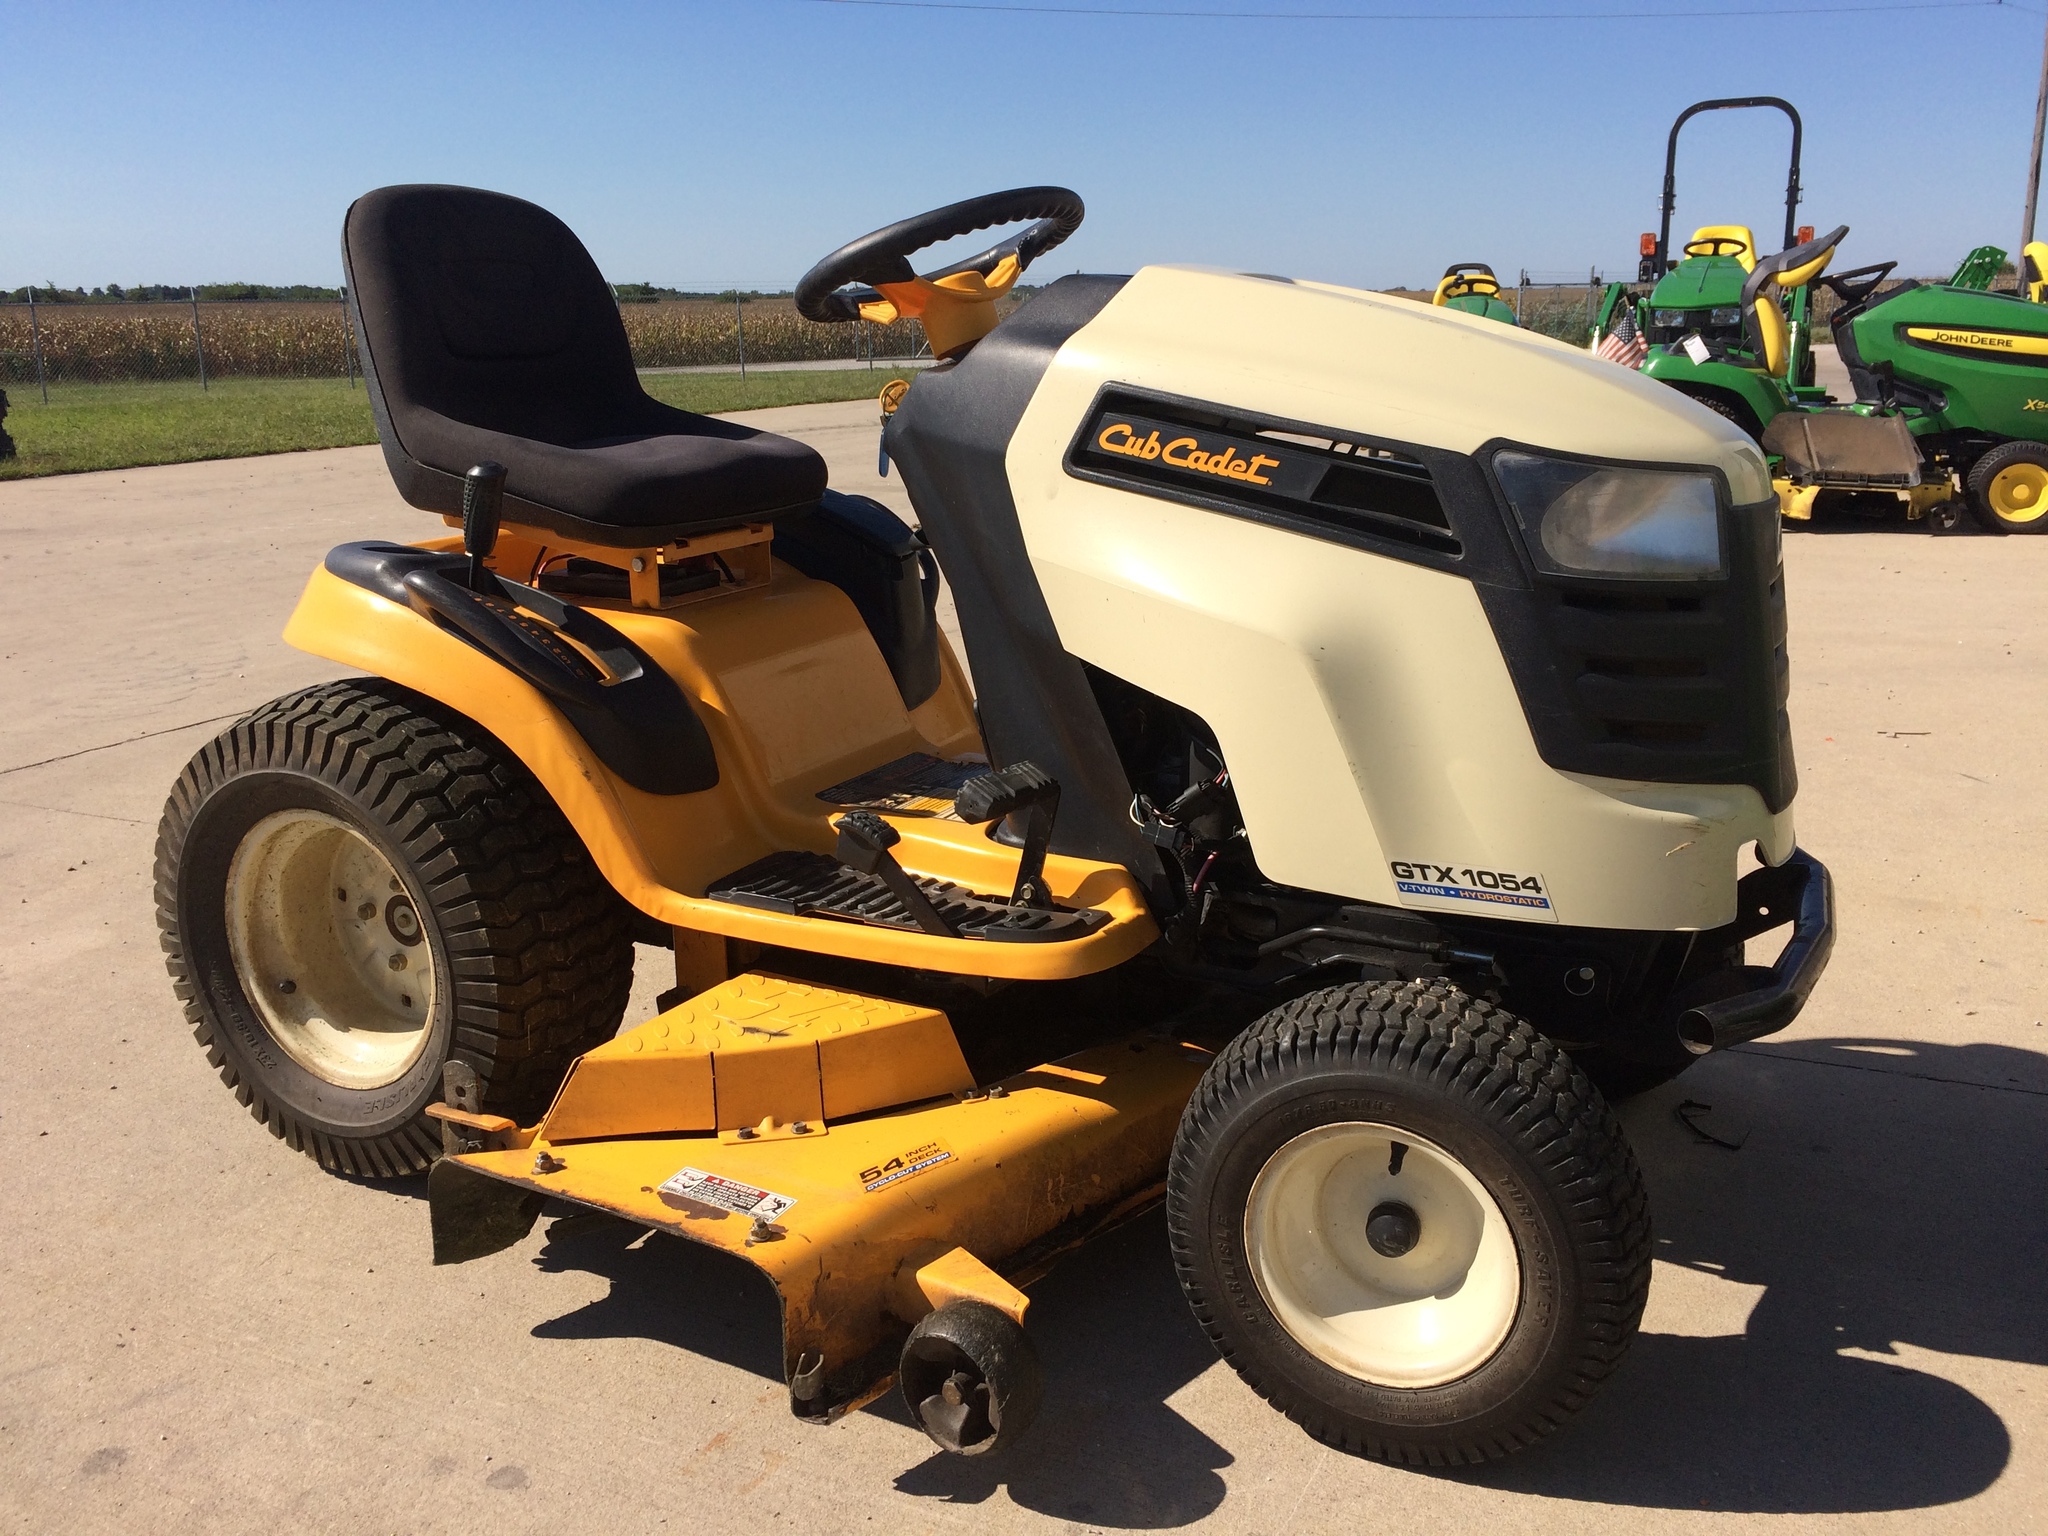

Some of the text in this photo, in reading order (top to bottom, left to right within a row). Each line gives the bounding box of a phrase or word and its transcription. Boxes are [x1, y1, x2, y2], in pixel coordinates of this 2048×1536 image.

[1931, 331, 2014, 348] JOHN DEERE
[1098, 423, 1280, 486] Cub Cadet
[1390, 861, 1542, 895] GTX 1054
[1399, 884, 1546, 907] V-TWIN HYDROSTATIC
[859, 1142, 937, 1184] 54 INCH
[908, 1147, 943, 1164] DECK
[866, 1152, 949, 1191] CYCLO-CUT SYSTEM
[721, 1180, 760, 1195] DANGER
